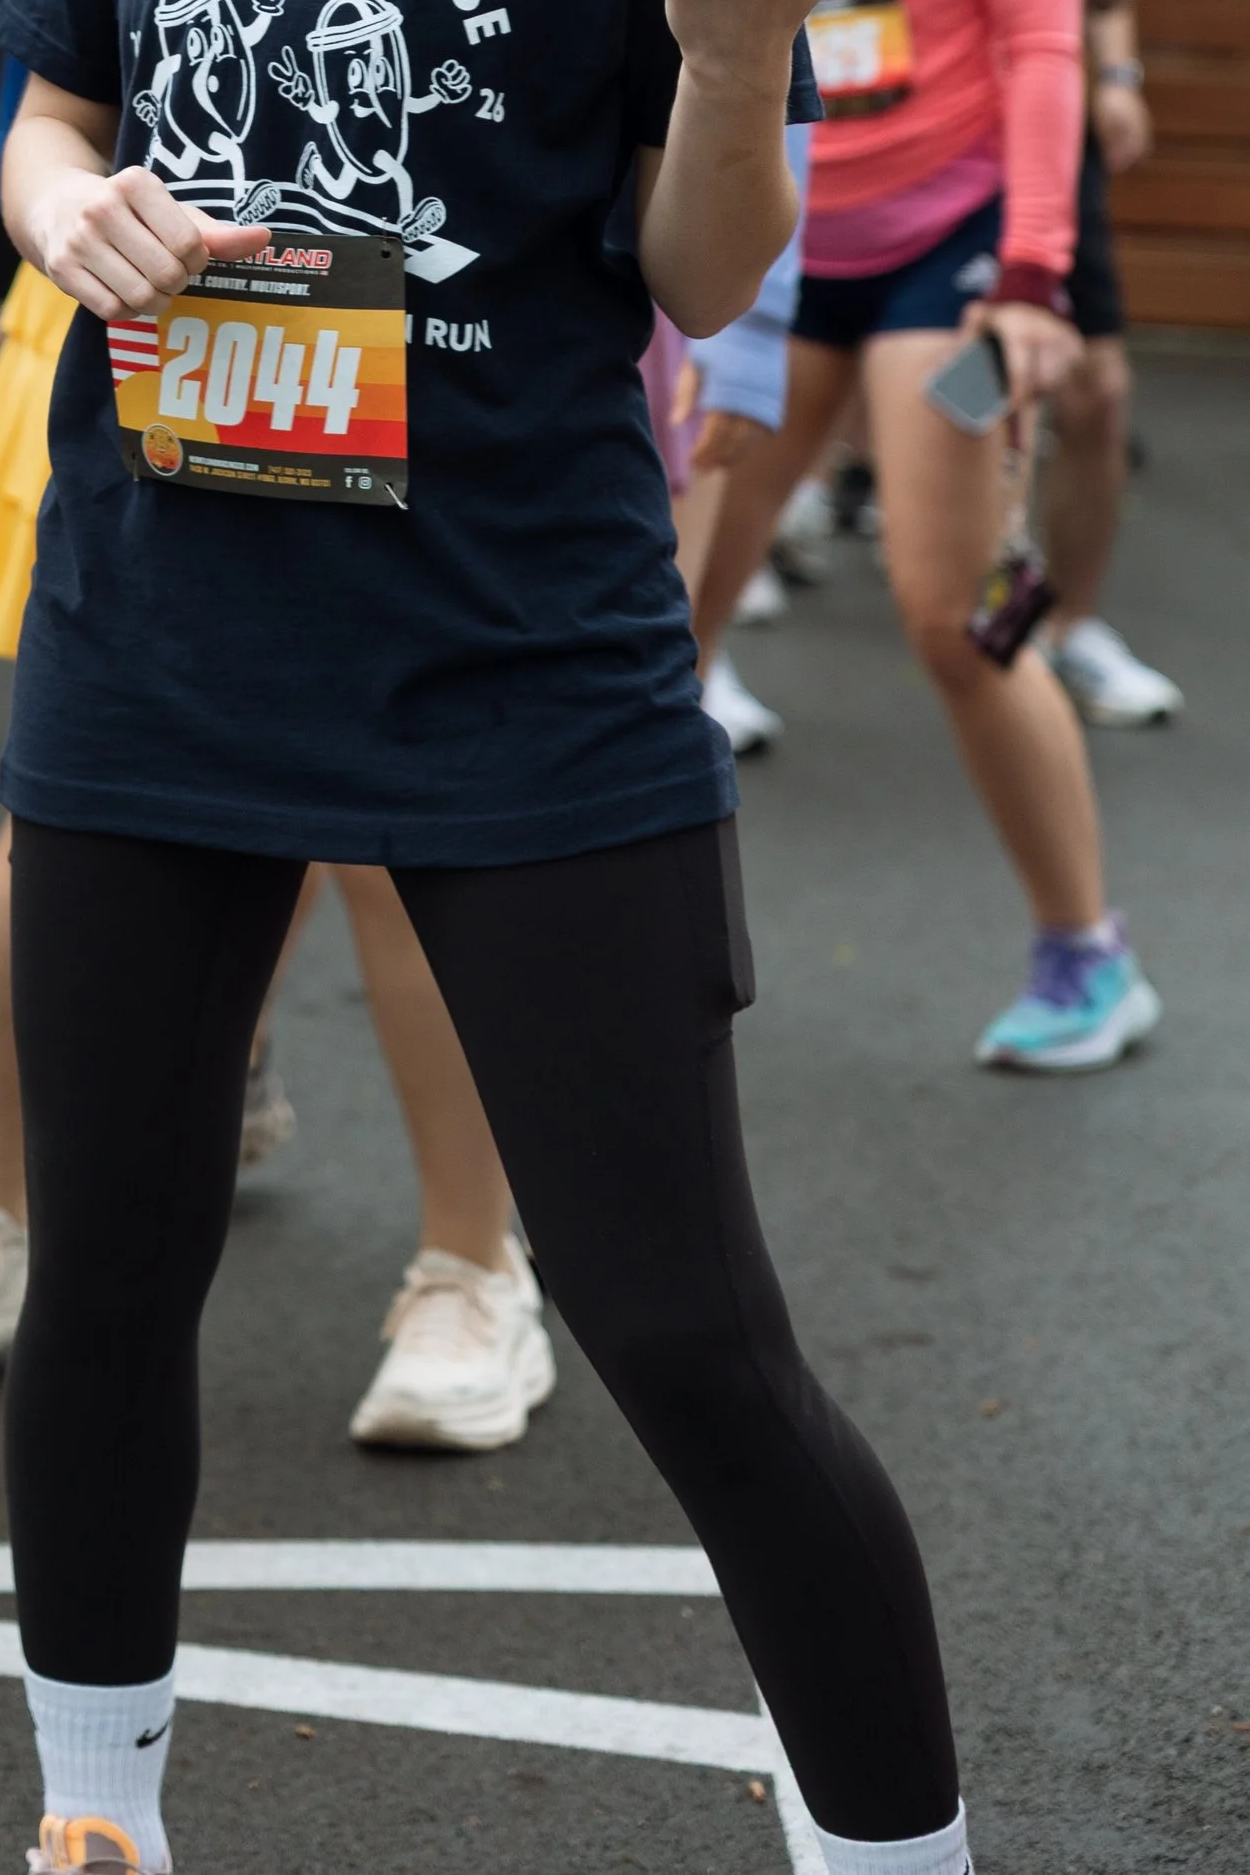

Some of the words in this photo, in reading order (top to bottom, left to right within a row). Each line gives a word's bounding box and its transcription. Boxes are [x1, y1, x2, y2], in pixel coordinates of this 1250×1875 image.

[475, 88, 505, 123] 26
[425, 317, 492, 353] RUN
[157, 315, 362, 436] 2044
